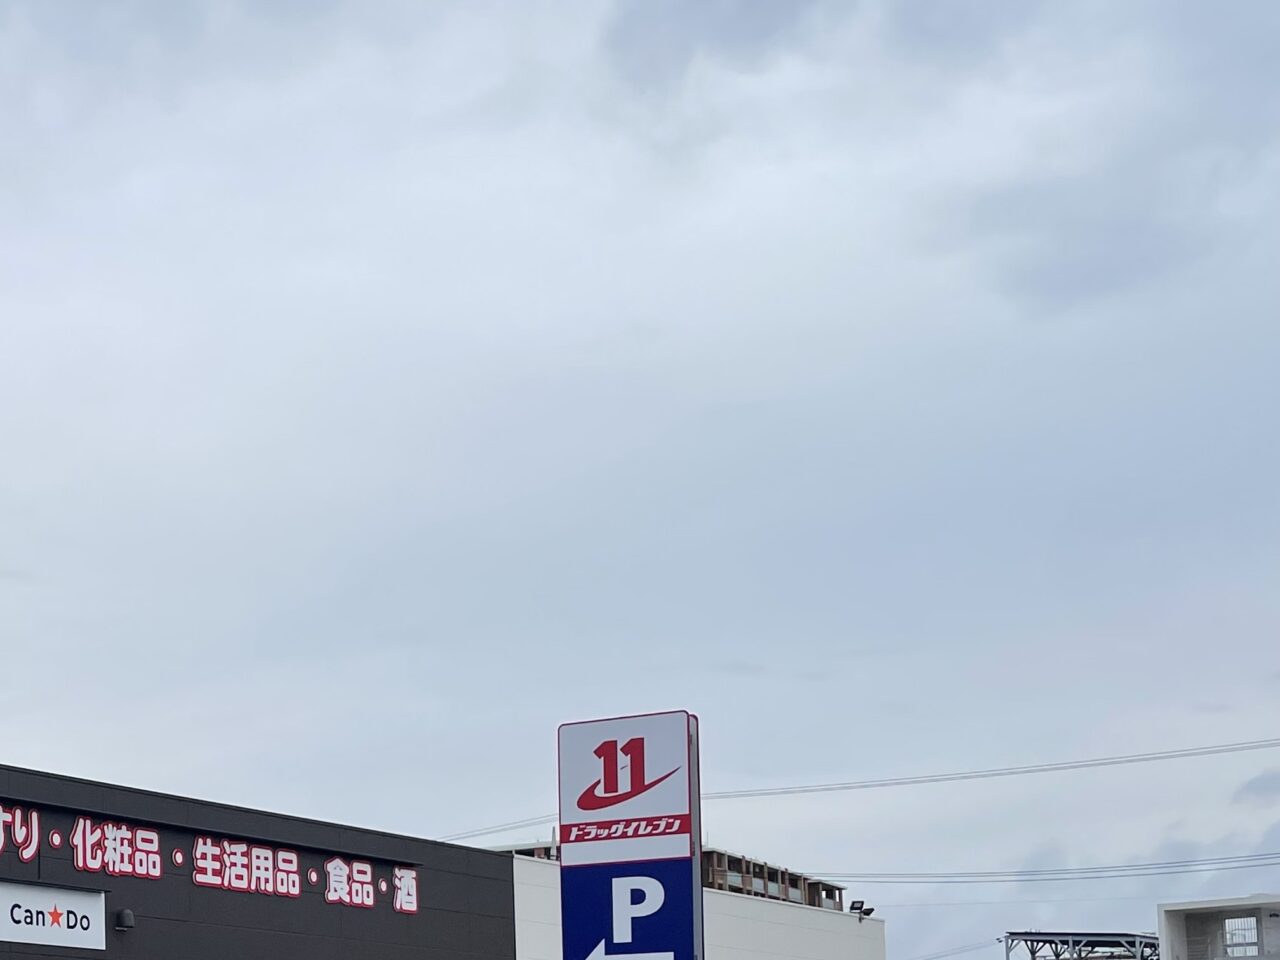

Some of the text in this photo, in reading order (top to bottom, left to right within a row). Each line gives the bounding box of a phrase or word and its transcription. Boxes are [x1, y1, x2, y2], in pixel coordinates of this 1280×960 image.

[569, 817, 681, 842] ドラッグイレブン
[611, 875, 666, 945] P
